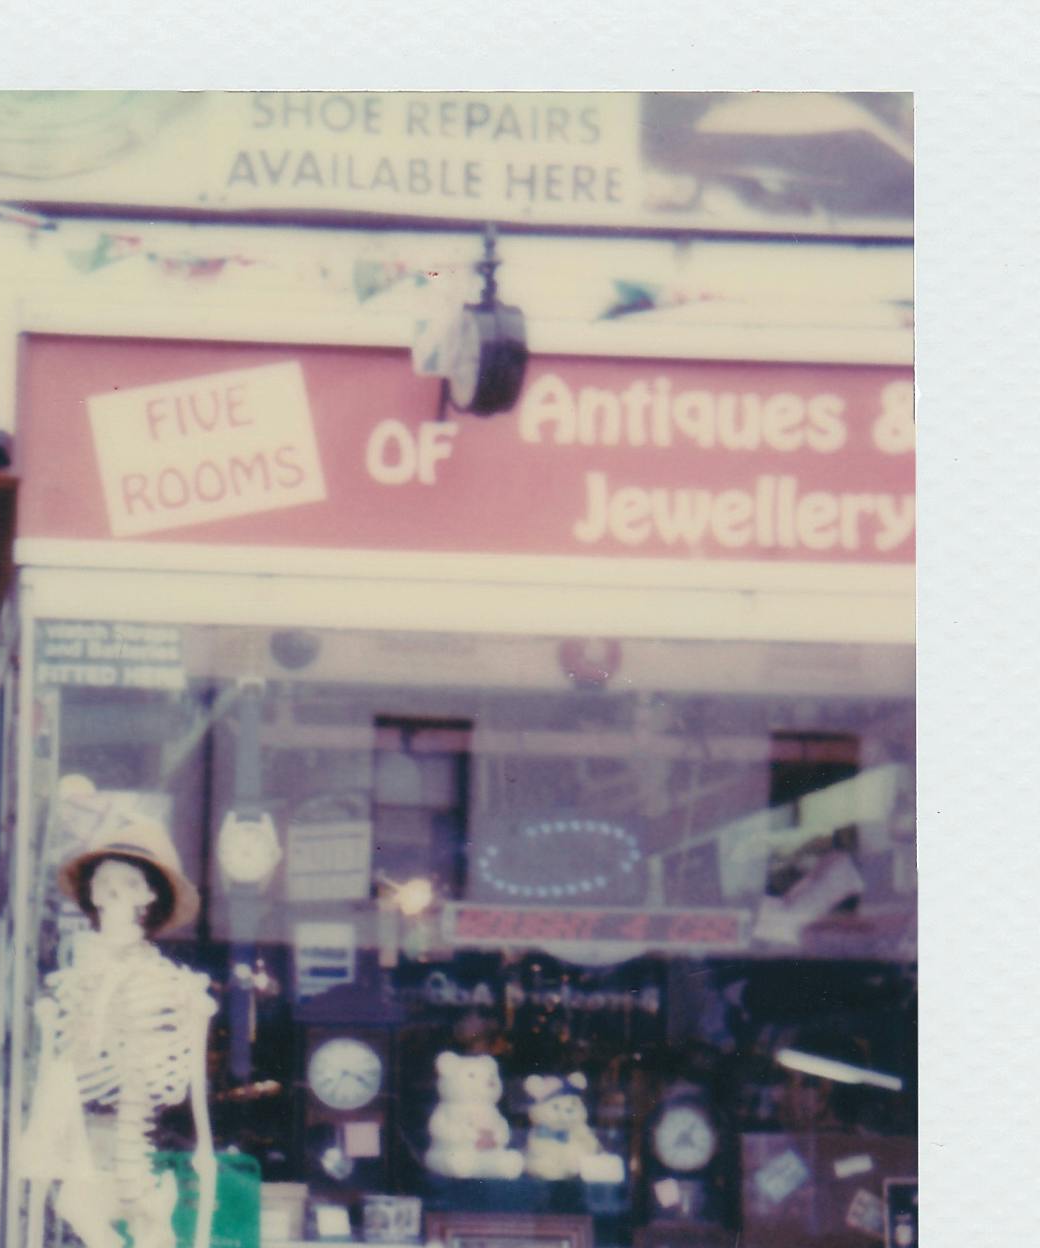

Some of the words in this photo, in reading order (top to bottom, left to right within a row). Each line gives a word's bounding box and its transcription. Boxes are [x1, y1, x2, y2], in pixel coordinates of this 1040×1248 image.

[250, 89, 383, 135] SHOE
[405, 98, 602, 145] REPAIRS
[226, 149, 482, 199] AVAILABLE
[505, 161, 623, 203] HERE
[144, 383, 254, 441] FIVE
[516, 373, 849, 454] Antiques
[871, 379, 915, 455] &
[120, 444, 306, 515] ROOMS
[364, 418, 460, 487] OF
[571, 470, 915, 552] Jewellery
